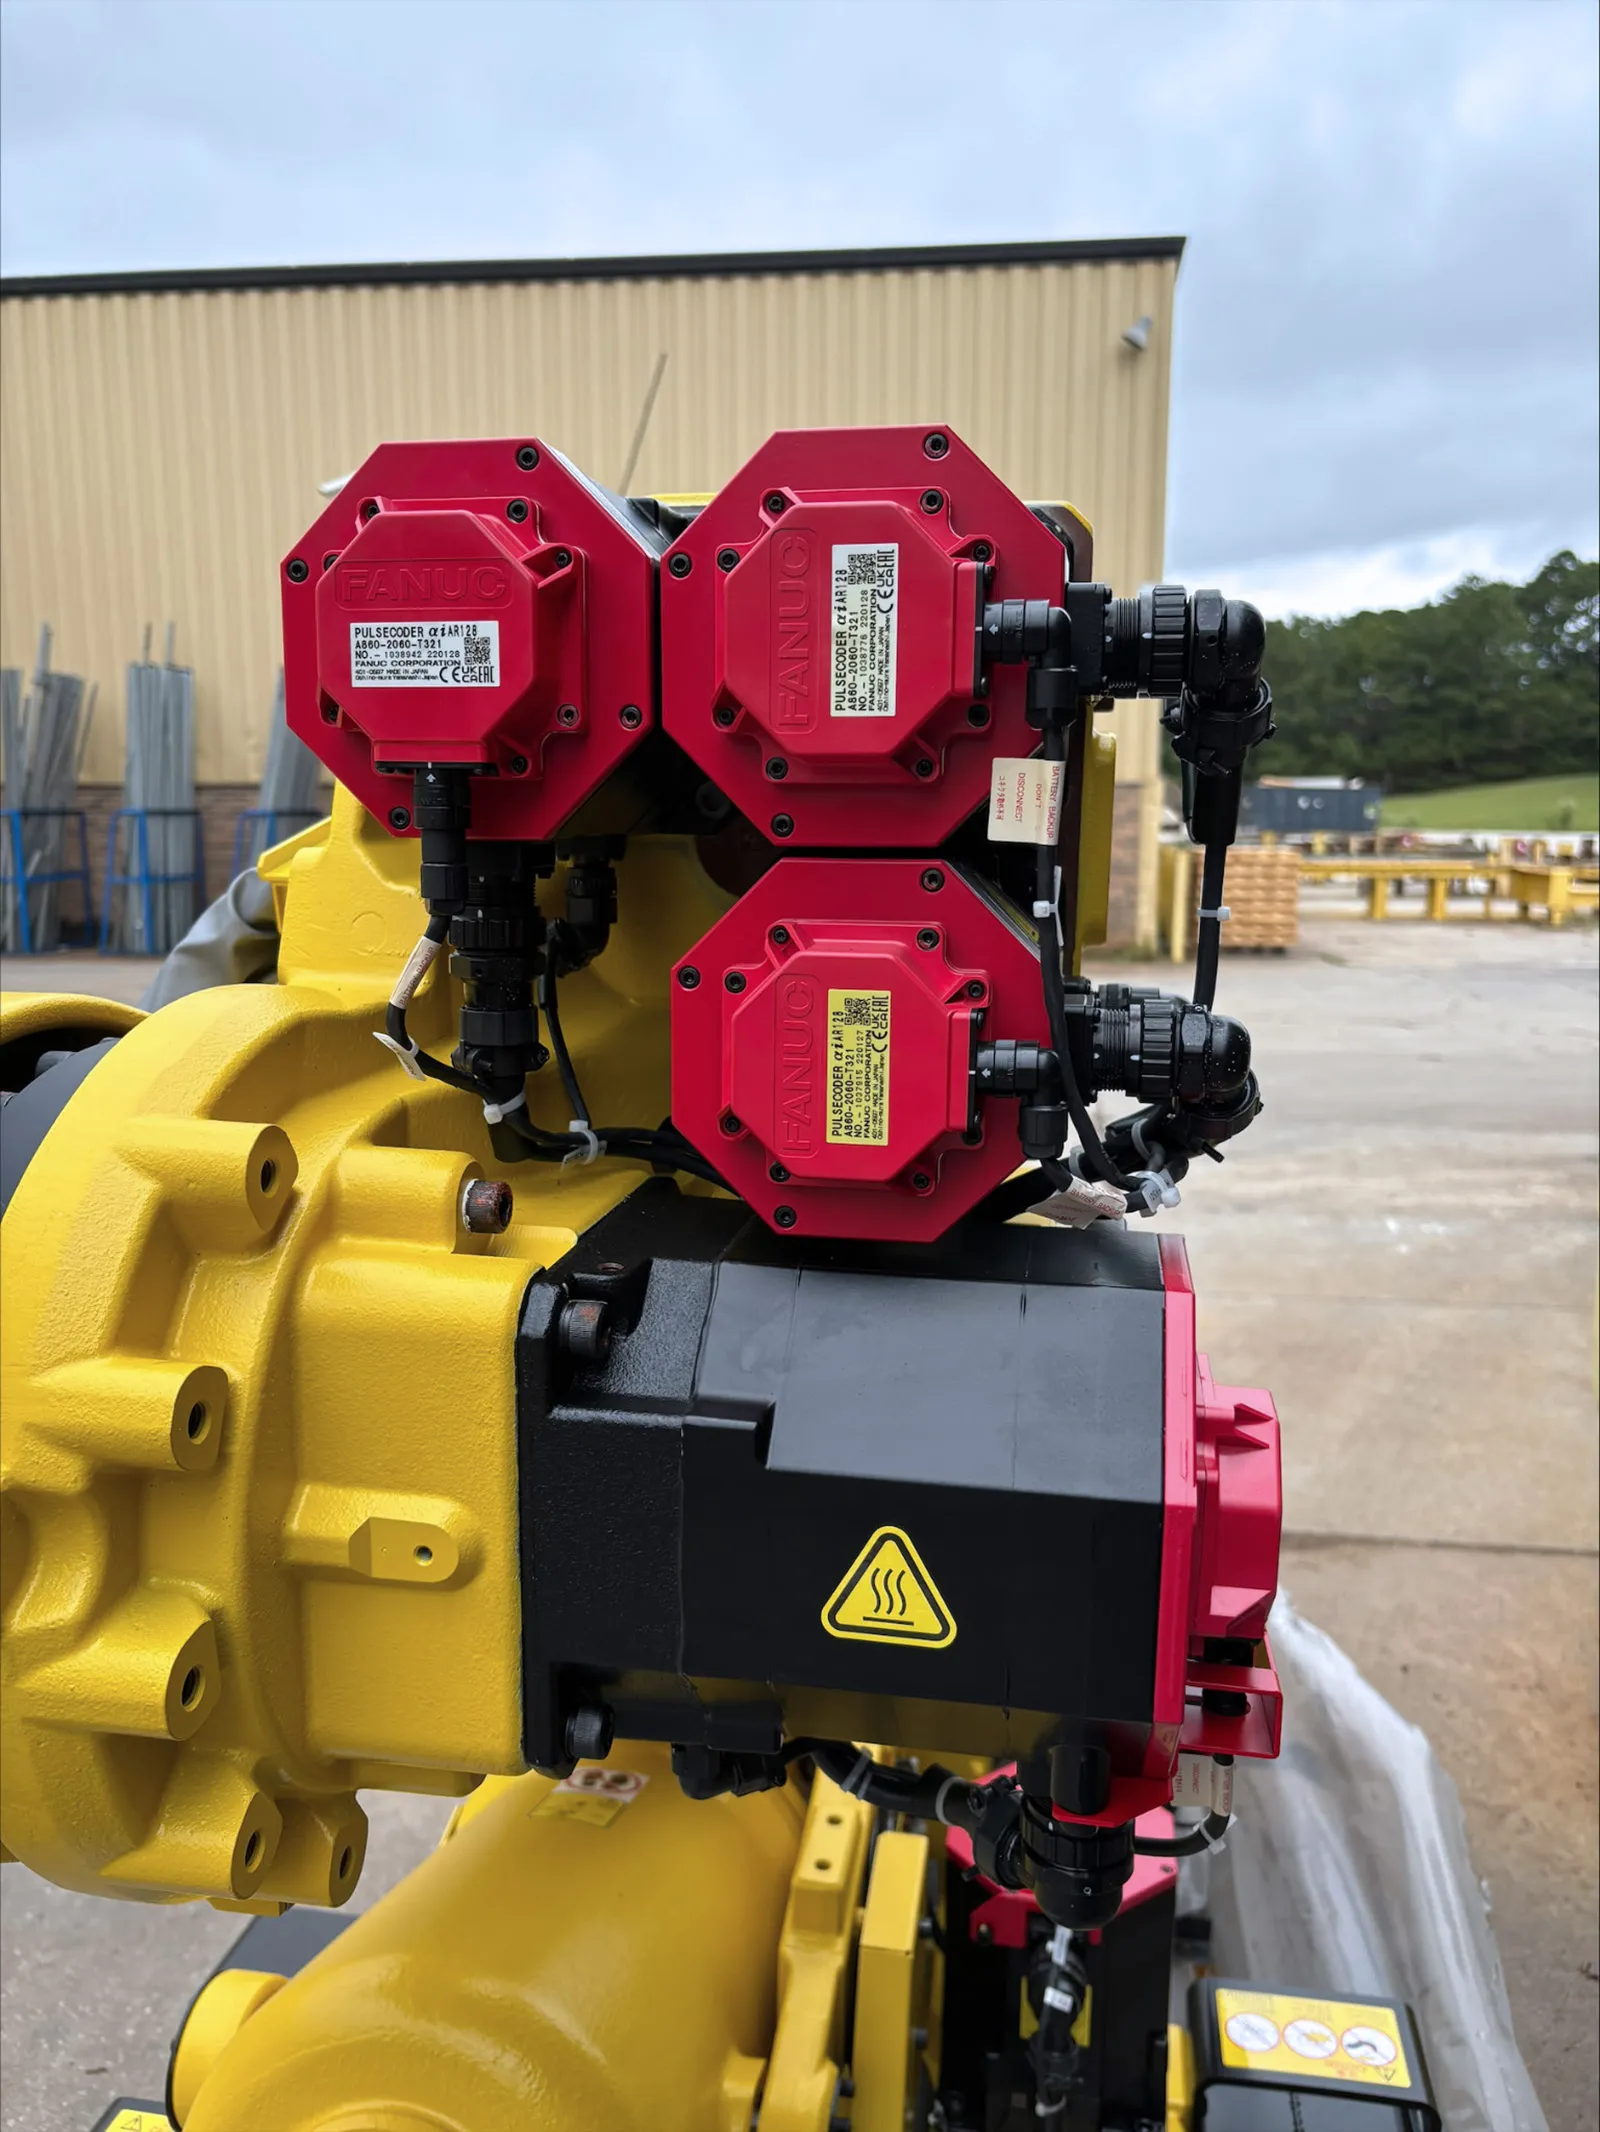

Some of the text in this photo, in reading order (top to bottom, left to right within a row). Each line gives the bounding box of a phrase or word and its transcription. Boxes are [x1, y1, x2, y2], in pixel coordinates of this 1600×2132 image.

[341, 567, 506, 601] FANUC
[860, 590, 868, 627] 220128
[355, 626, 424, 638] PULSECODER
[355, 640, 441, 649] A860-2060-T321
[428, 650, 460, 658] 220128
[778, 536, 811, 728] FANUC
[859, 634, 867, 676] 1038776
[836, 631, 847, 711] PULSECODER
[848, 611, 858, 711] A860-2060-T321
[1015, 772, 1026, 823] DISCONNECT
[1047, 766, 1060, 838] BATTERY BACKUP
[783, 981, 814, 1152] FANUC
[832, 1066, 843, 1136] PULSECODER
[844, 1049, 854, 1137] A860-2060-T321
[1069, 1188, 1097, 1206] BATTERY
[1097, 1202, 1121, 1217] BACKUP
